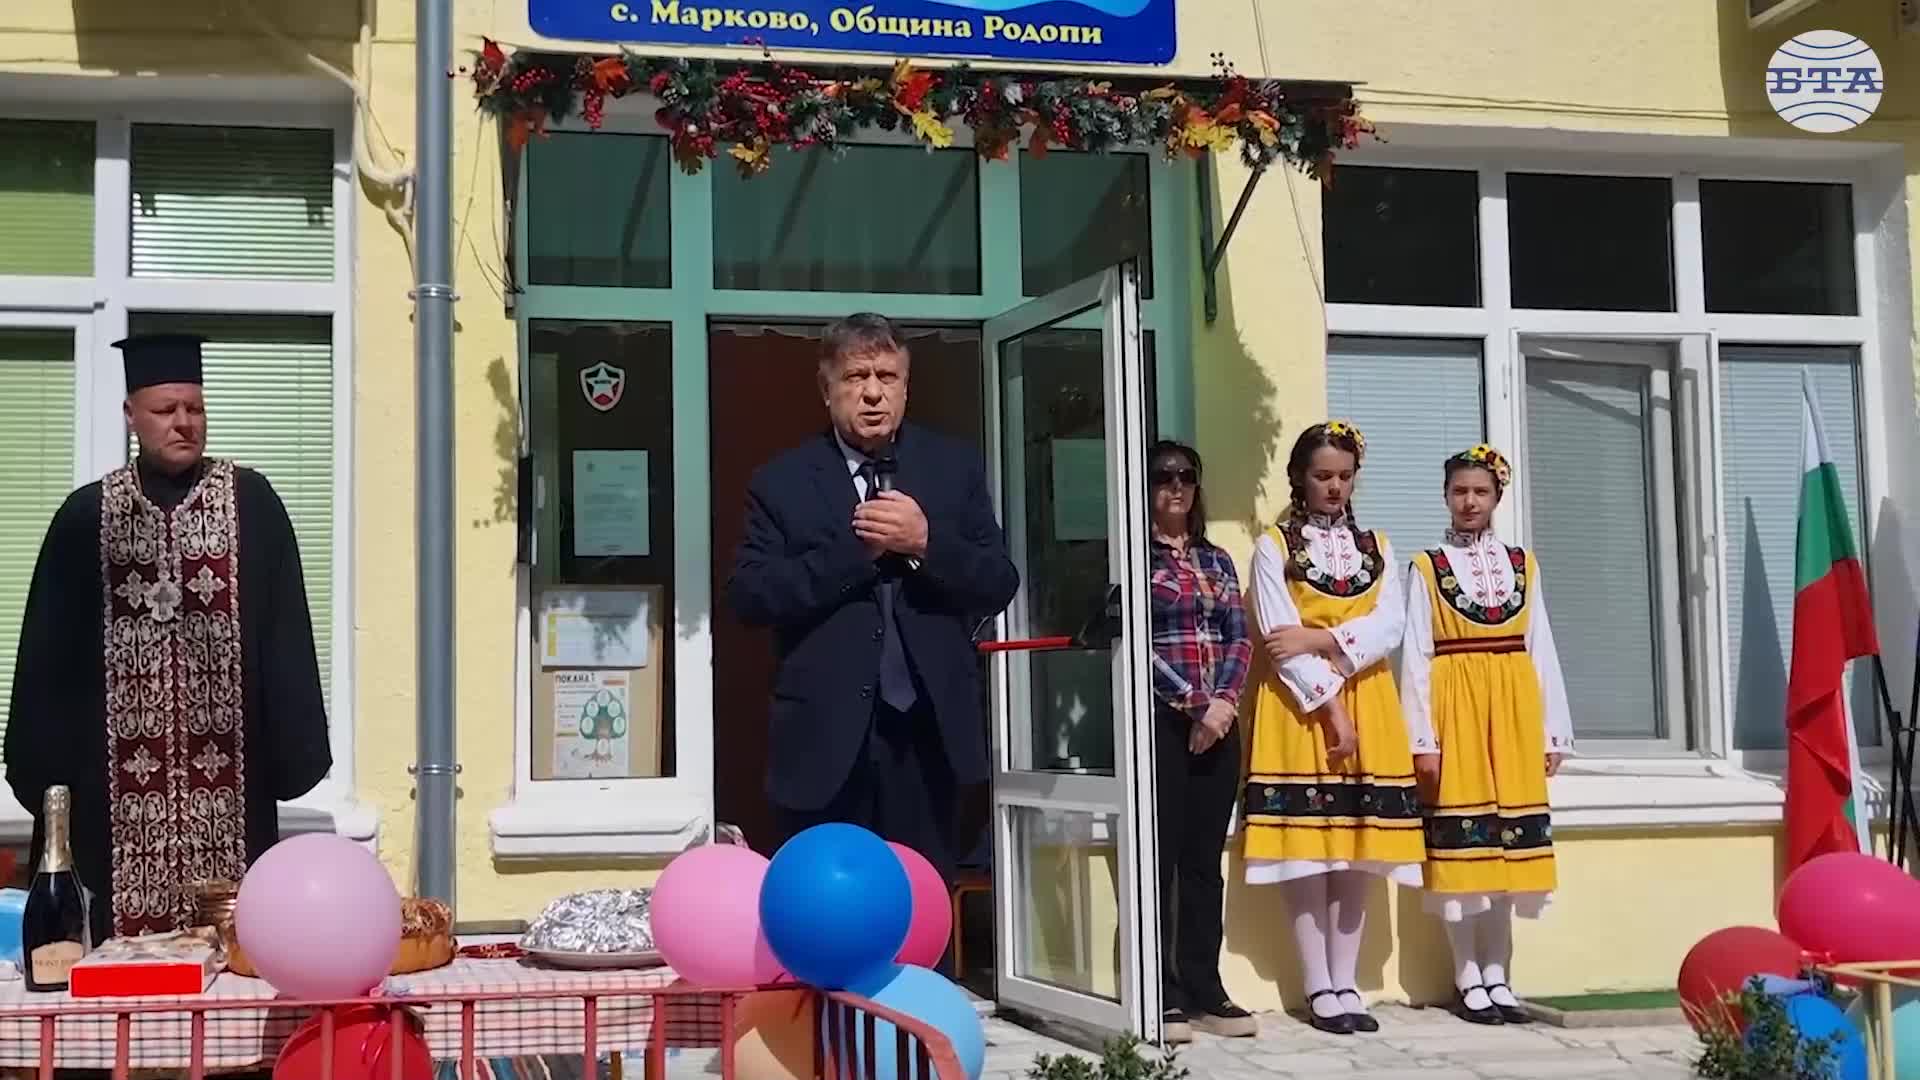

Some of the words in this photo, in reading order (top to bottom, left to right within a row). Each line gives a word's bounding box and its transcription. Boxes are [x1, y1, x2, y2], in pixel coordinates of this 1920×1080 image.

[611, 4, 639, 22] с.
[651, 0, 819, 36] Марково,
[829, 5, 972, 38] Община
[983, 16, 1102, 44] Родопи
